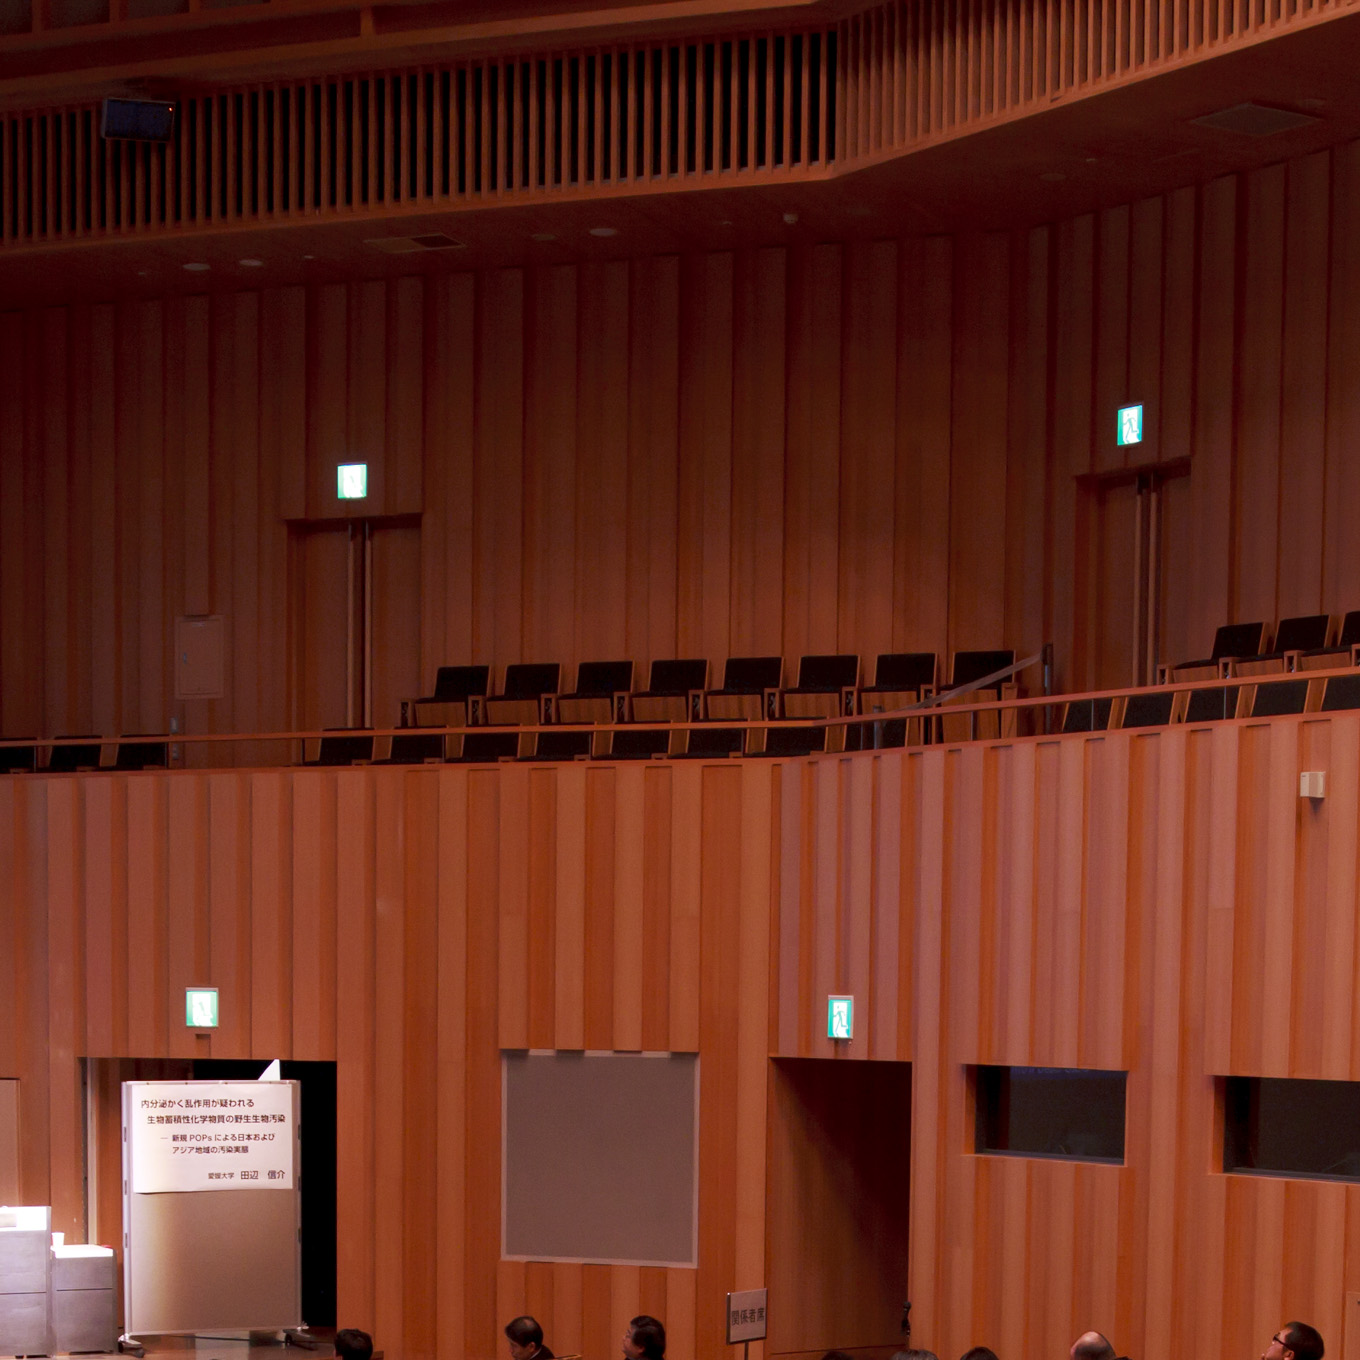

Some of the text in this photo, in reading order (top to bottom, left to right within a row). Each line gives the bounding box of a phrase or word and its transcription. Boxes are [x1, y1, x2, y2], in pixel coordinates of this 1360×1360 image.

[189, 1134, 213, 1142] POPs
[214, 1133, 275, 1142] による日本および
